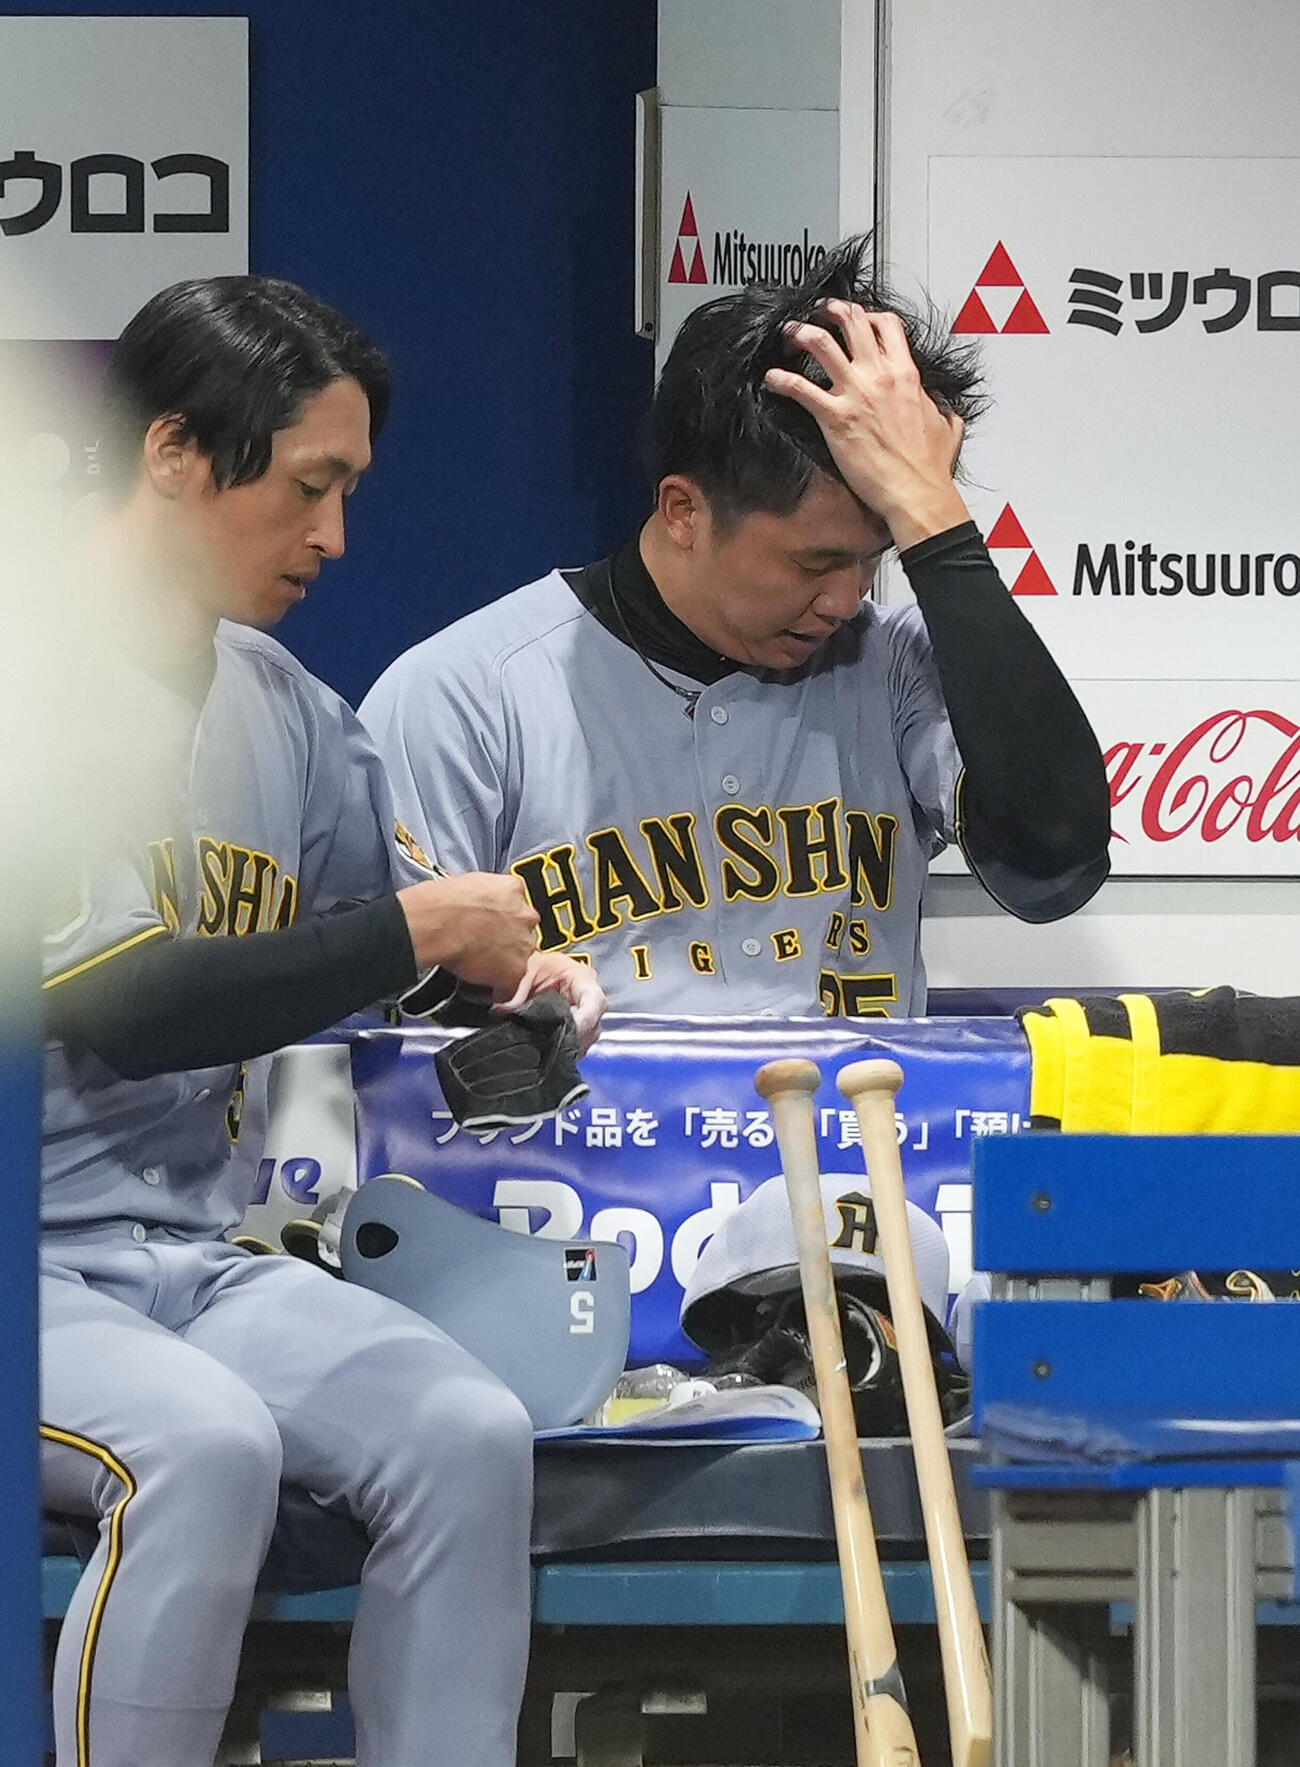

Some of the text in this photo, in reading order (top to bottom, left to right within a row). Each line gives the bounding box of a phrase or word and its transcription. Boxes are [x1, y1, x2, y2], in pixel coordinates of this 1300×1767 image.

[1067, 268, 1300, 336] ミツウロ
[1073, 540, 1300, 597] Mitsuuro
[511, 797, 898, 952] HANSHN
[566, 911, 872, 981] IGERS
